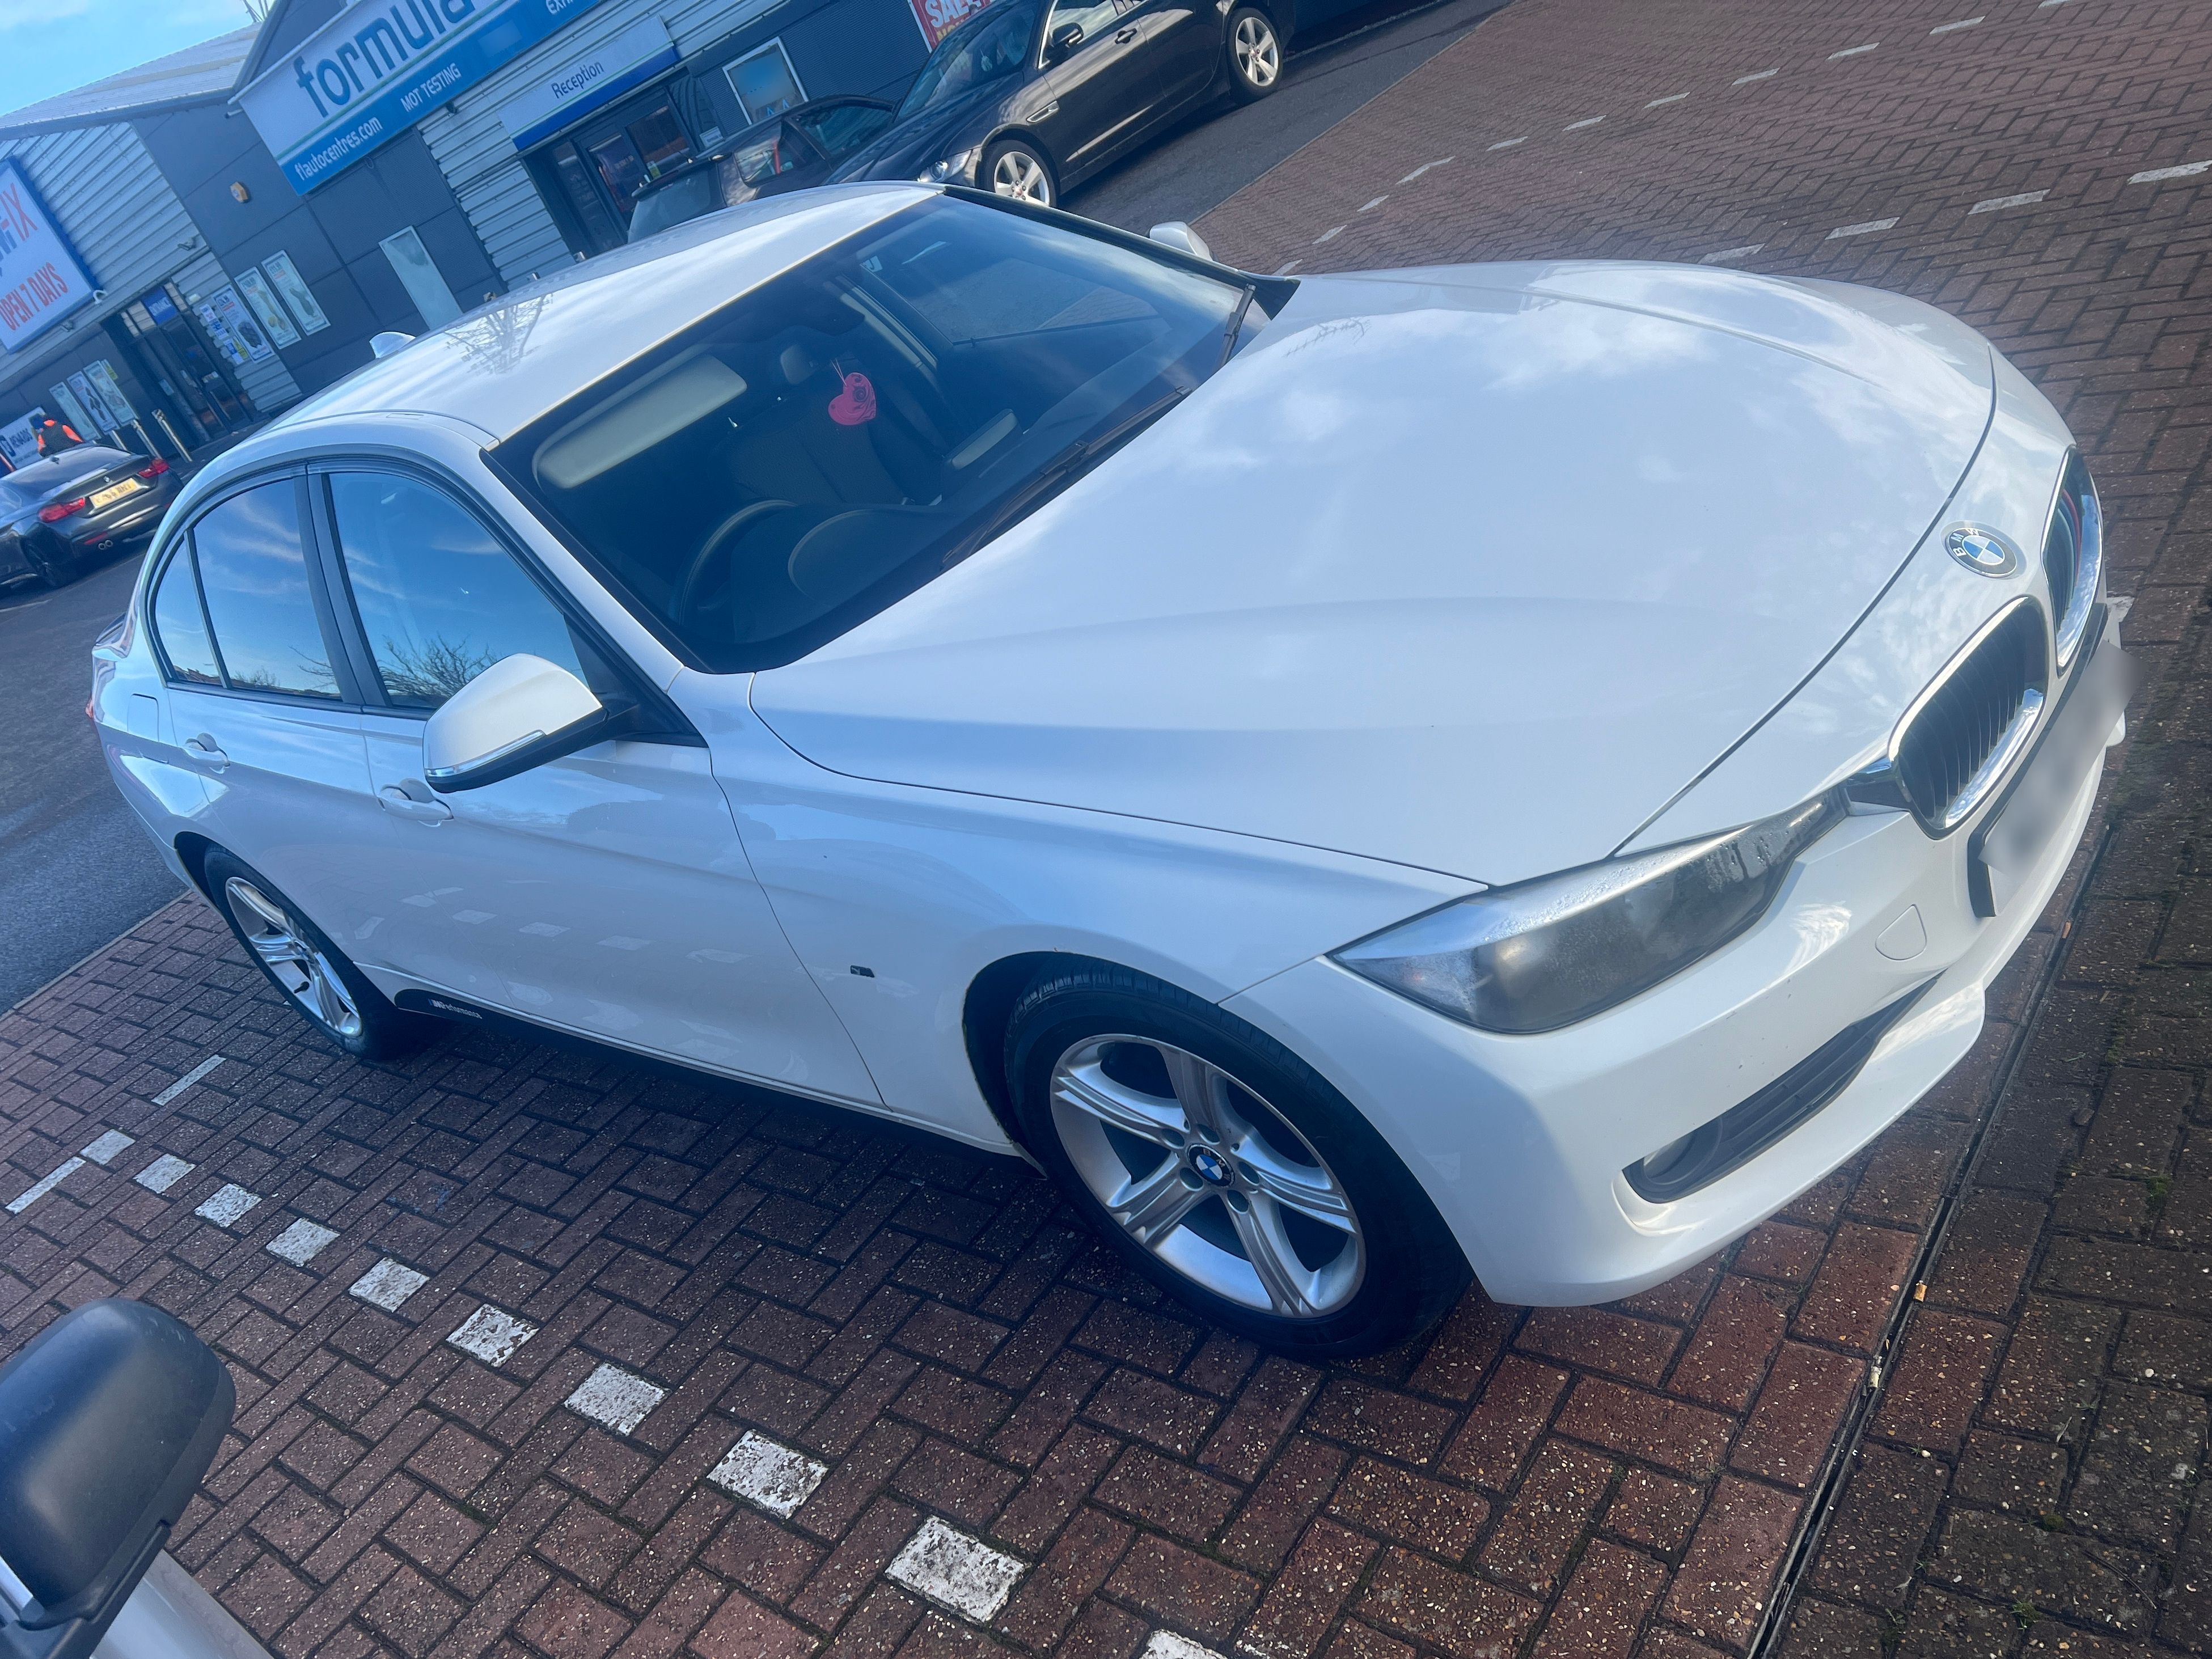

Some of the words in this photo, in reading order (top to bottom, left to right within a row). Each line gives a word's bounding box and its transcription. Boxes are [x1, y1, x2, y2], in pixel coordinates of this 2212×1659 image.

[400, 88, 423, 112] MOT
[424, 62, 461, 98] TESTING
[551, 61, 604, 99] Reception
[19, 283, 40, 312] 7
[27, 261, 68, 307] DAYS
[0, 289, 33, 331] OPEN
